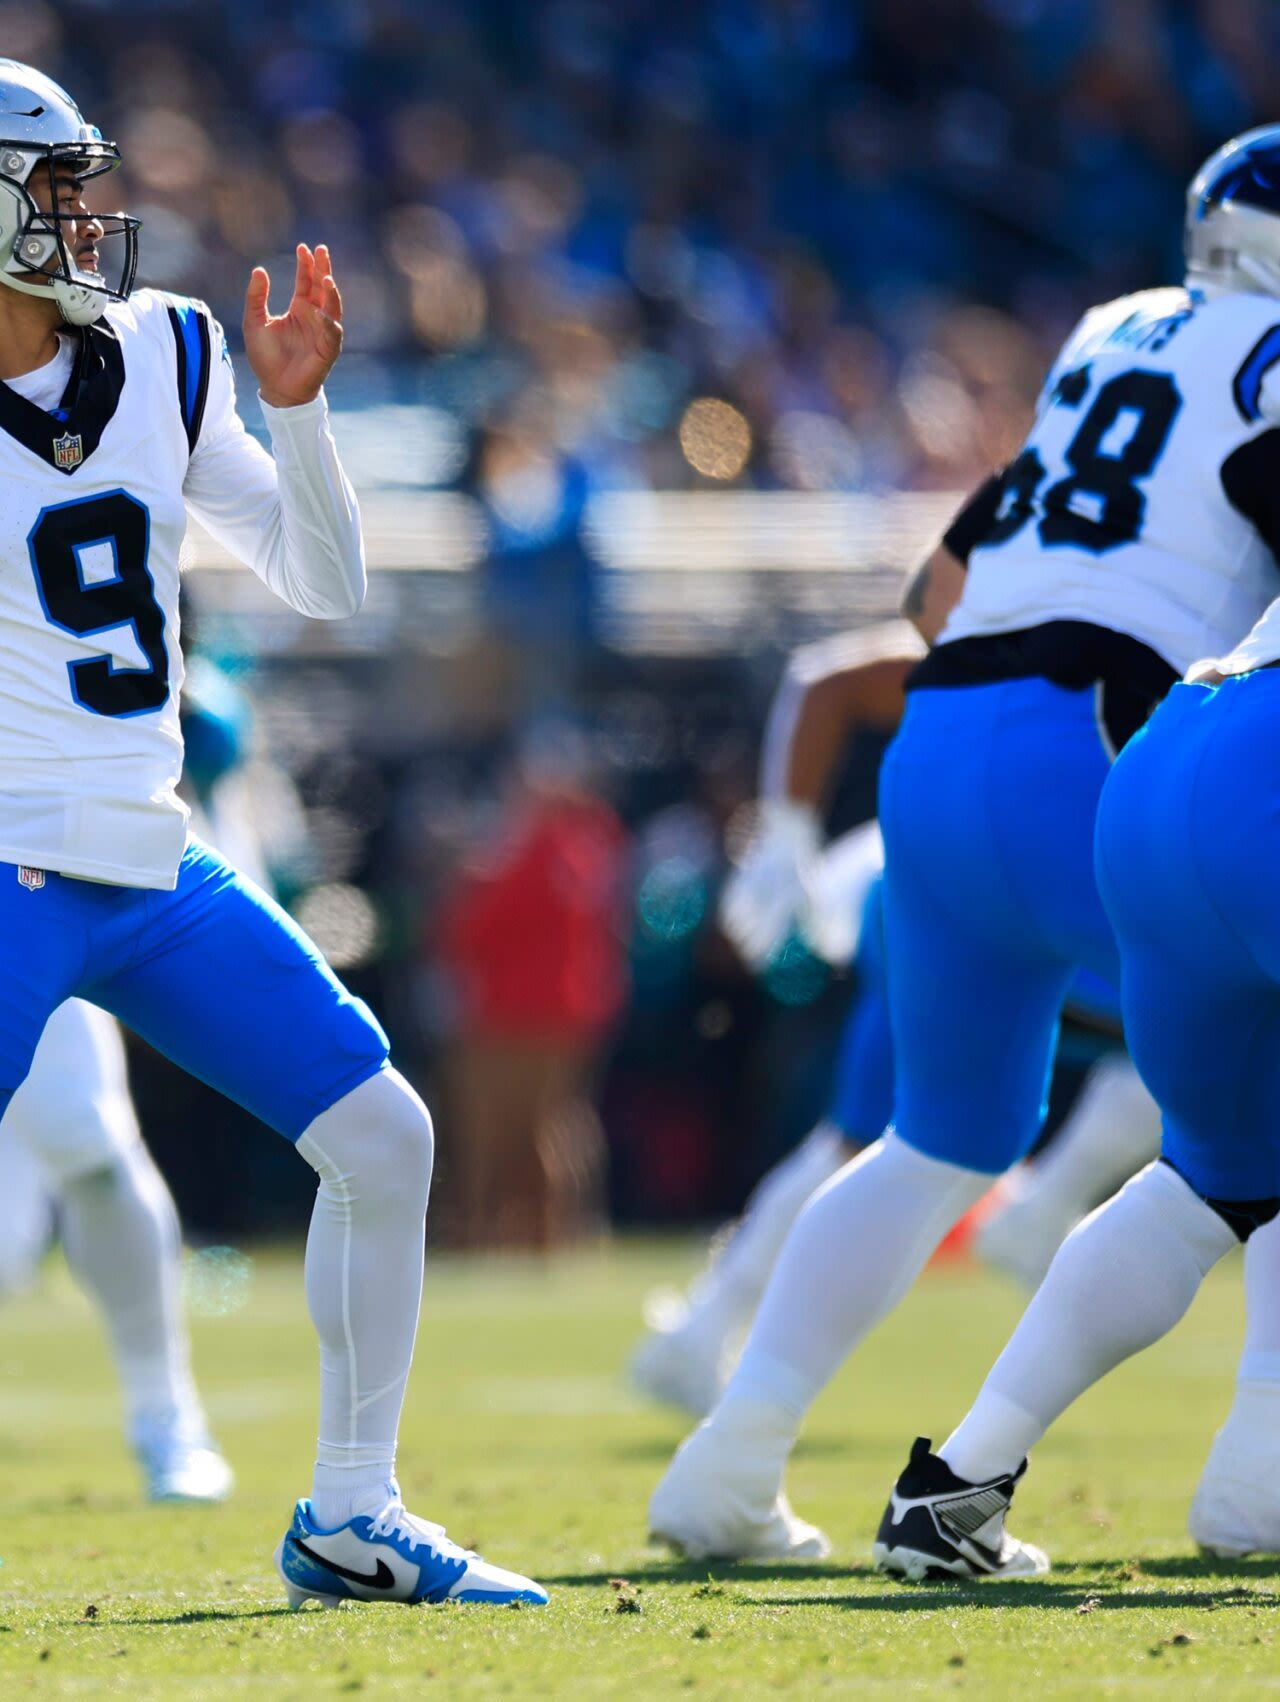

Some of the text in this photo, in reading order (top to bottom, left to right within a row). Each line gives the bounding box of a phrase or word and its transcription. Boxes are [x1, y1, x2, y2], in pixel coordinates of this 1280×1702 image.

[59, 448, 80, 464] NFL
[26, 487, 171, 720] 9
[22, 869, 43, 884] NFL
